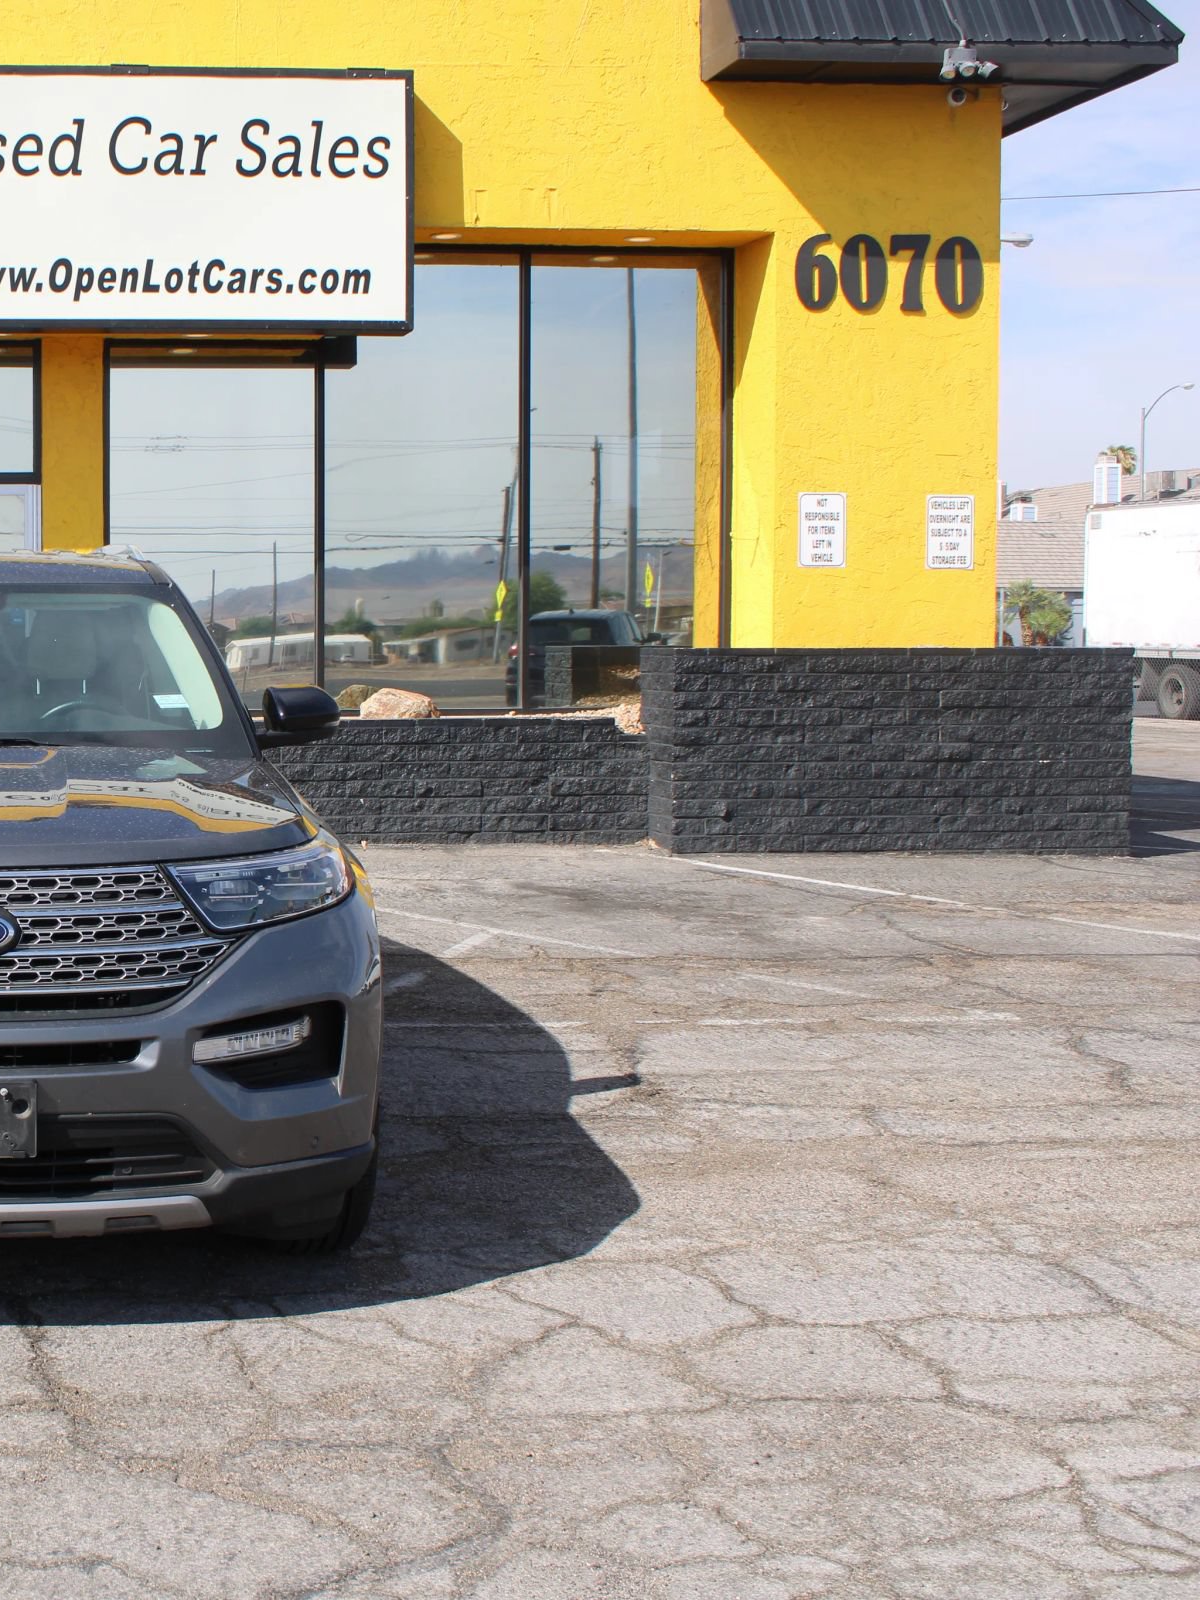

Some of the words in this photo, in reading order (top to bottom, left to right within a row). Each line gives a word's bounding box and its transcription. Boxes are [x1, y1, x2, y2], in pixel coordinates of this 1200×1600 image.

[109, 116, 218, 176] Car
[236, 119, 391, 178] Sales
[795, 233, 984, 314] 6070
[816, 498, 828, 507] NOT
[931, 501, 956, 510] VEHICLES
[957, 501, 970, 510] LEFT
[805, 512, 840, 521] RESPONSIBLE
[929, 514, 959, 524] OVERNIGHT
[960, 514, 971, 524] ARE
[808, 525, 818, 535] FOR
[819, 525, 836, 535] ITEMS
[931, 528, 954, 537] SUBJECT
[812, 539, 825, 549] LEFT
[811, 553, 833, 562] VEHICLE
[932, 556, 956, 565] STORAGE
[957, 556, 967, 565] FEE
